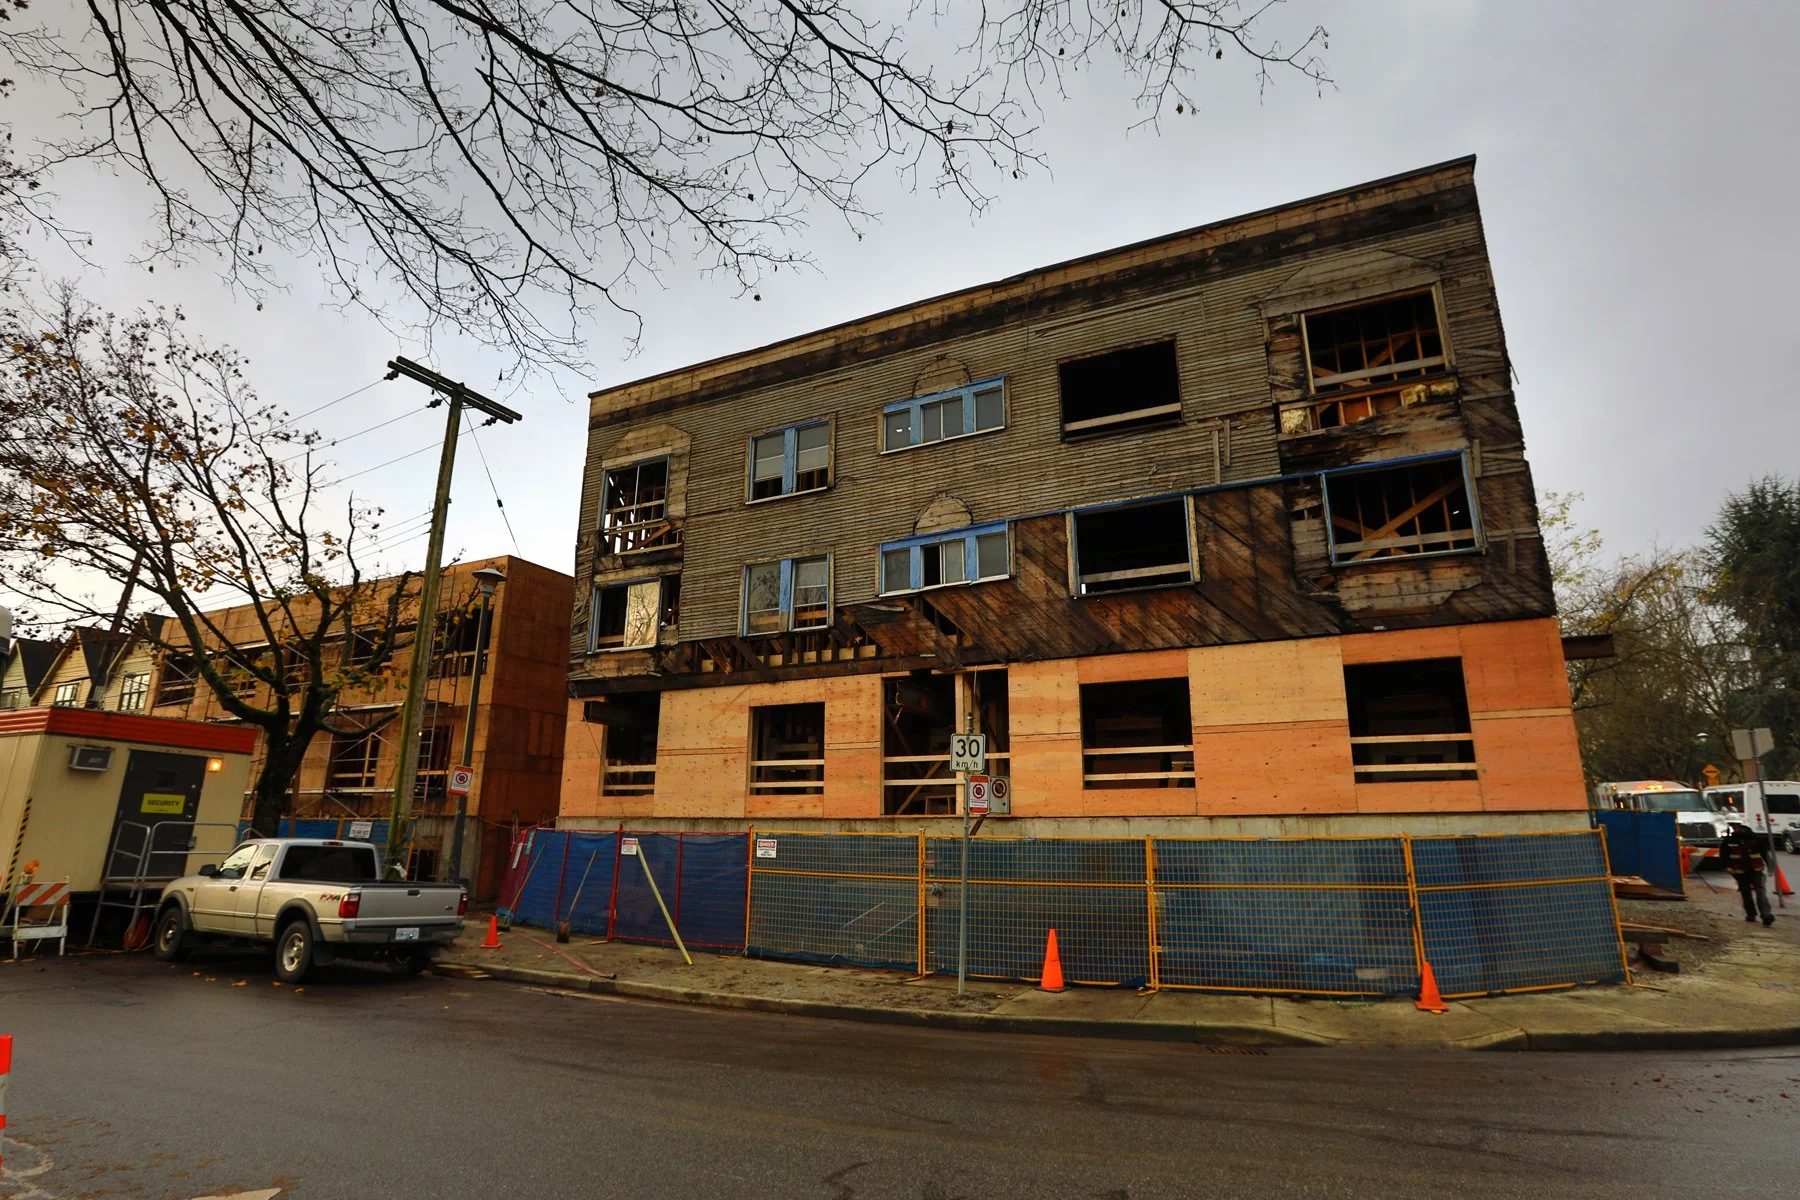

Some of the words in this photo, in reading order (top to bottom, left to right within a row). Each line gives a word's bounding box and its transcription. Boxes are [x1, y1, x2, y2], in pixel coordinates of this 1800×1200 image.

[955, 738, 980, 758] 30
[956, 760, 979, 769] km/h
[319, 893, 341, 901] FX4
